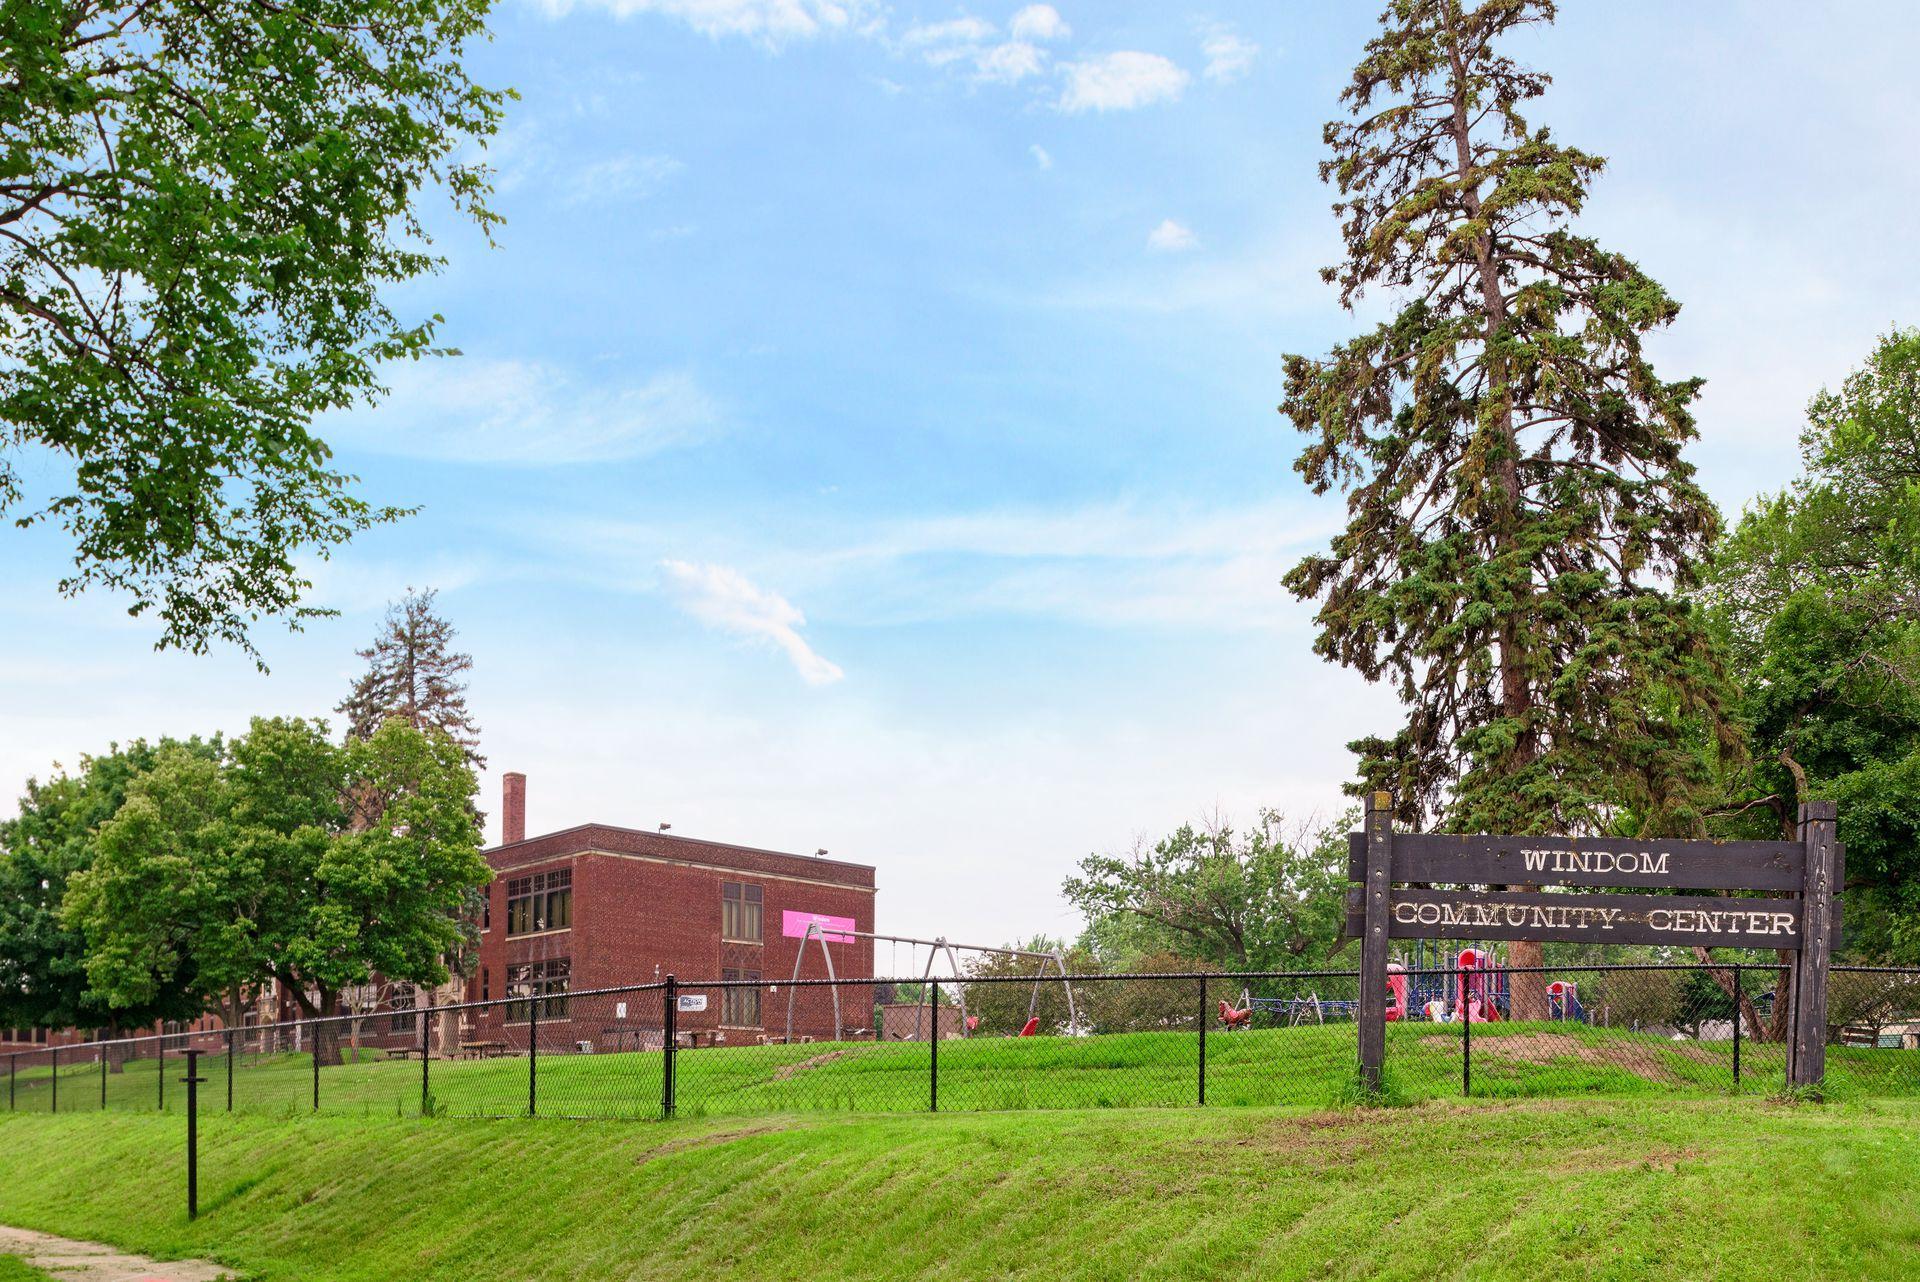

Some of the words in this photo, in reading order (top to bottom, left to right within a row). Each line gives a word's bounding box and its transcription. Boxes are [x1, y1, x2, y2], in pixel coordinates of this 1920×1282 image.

[1520, 849, 1670, 874] WINDOM
[1394, 902, 1621, 930] COMMUNITY
[1649, 910, 1796, 936] CENTER
